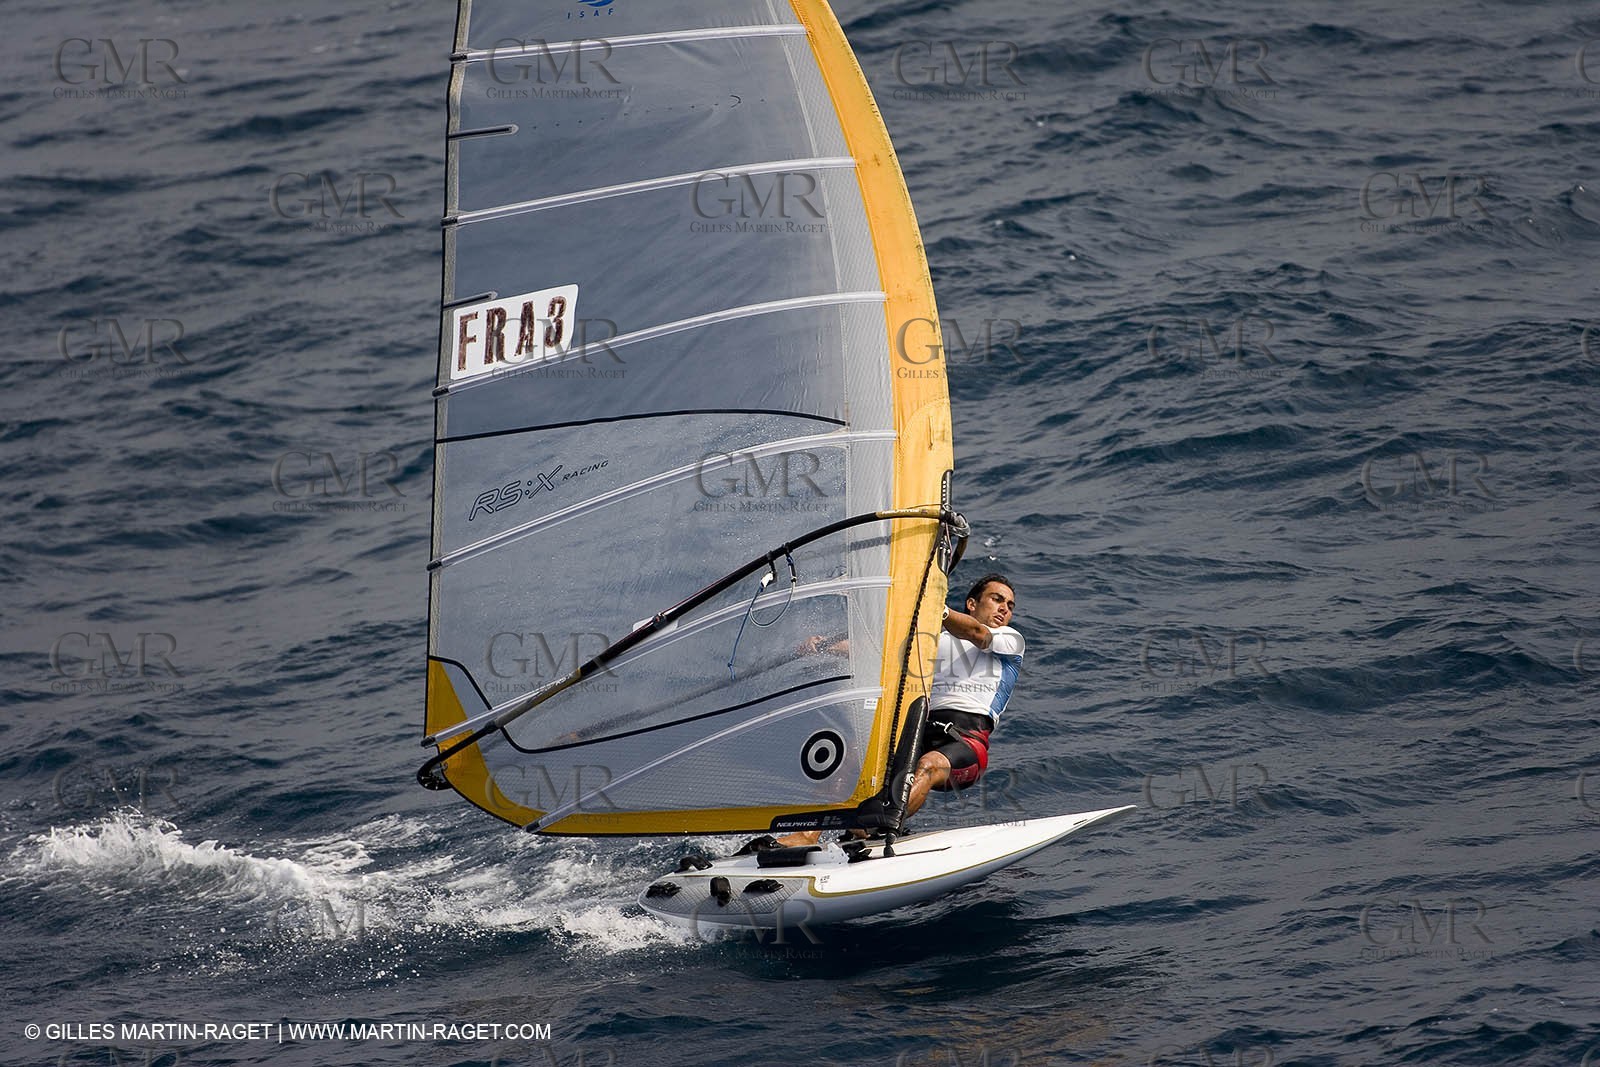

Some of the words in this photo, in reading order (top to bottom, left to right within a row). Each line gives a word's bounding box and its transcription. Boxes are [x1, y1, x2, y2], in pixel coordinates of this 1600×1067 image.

[567, 8, 614, 19] ISAF
[469, 465, 563, 521] RS:X
[562, 460, 609, 481] RACING
